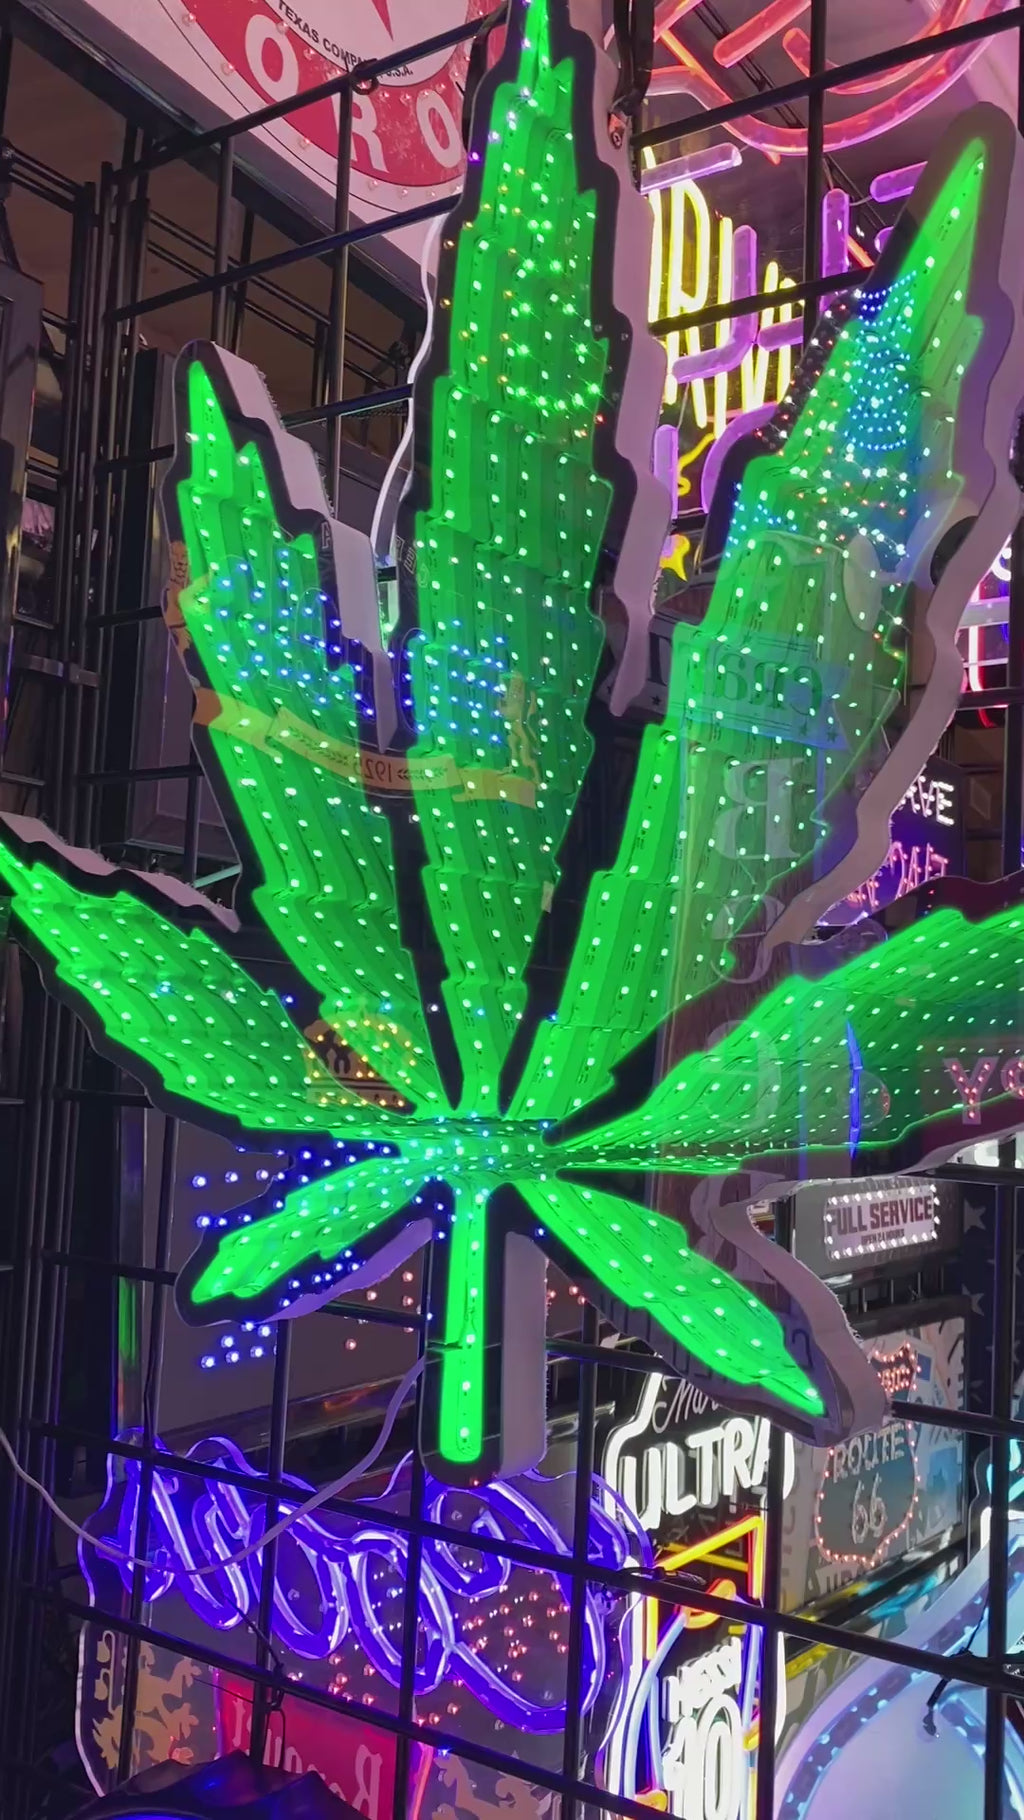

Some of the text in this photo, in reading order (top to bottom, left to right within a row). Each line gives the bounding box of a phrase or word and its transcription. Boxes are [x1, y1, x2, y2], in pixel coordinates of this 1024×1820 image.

[278, 0, 319, 43] TEXAS
[826, 1195, 933, 1236] FULL SERVICE
[621, 1417, 771, 1534] ULTRA
[832, 1421, 906, 1484] ROUTE
[851, 1473, 889, 1545] 66
